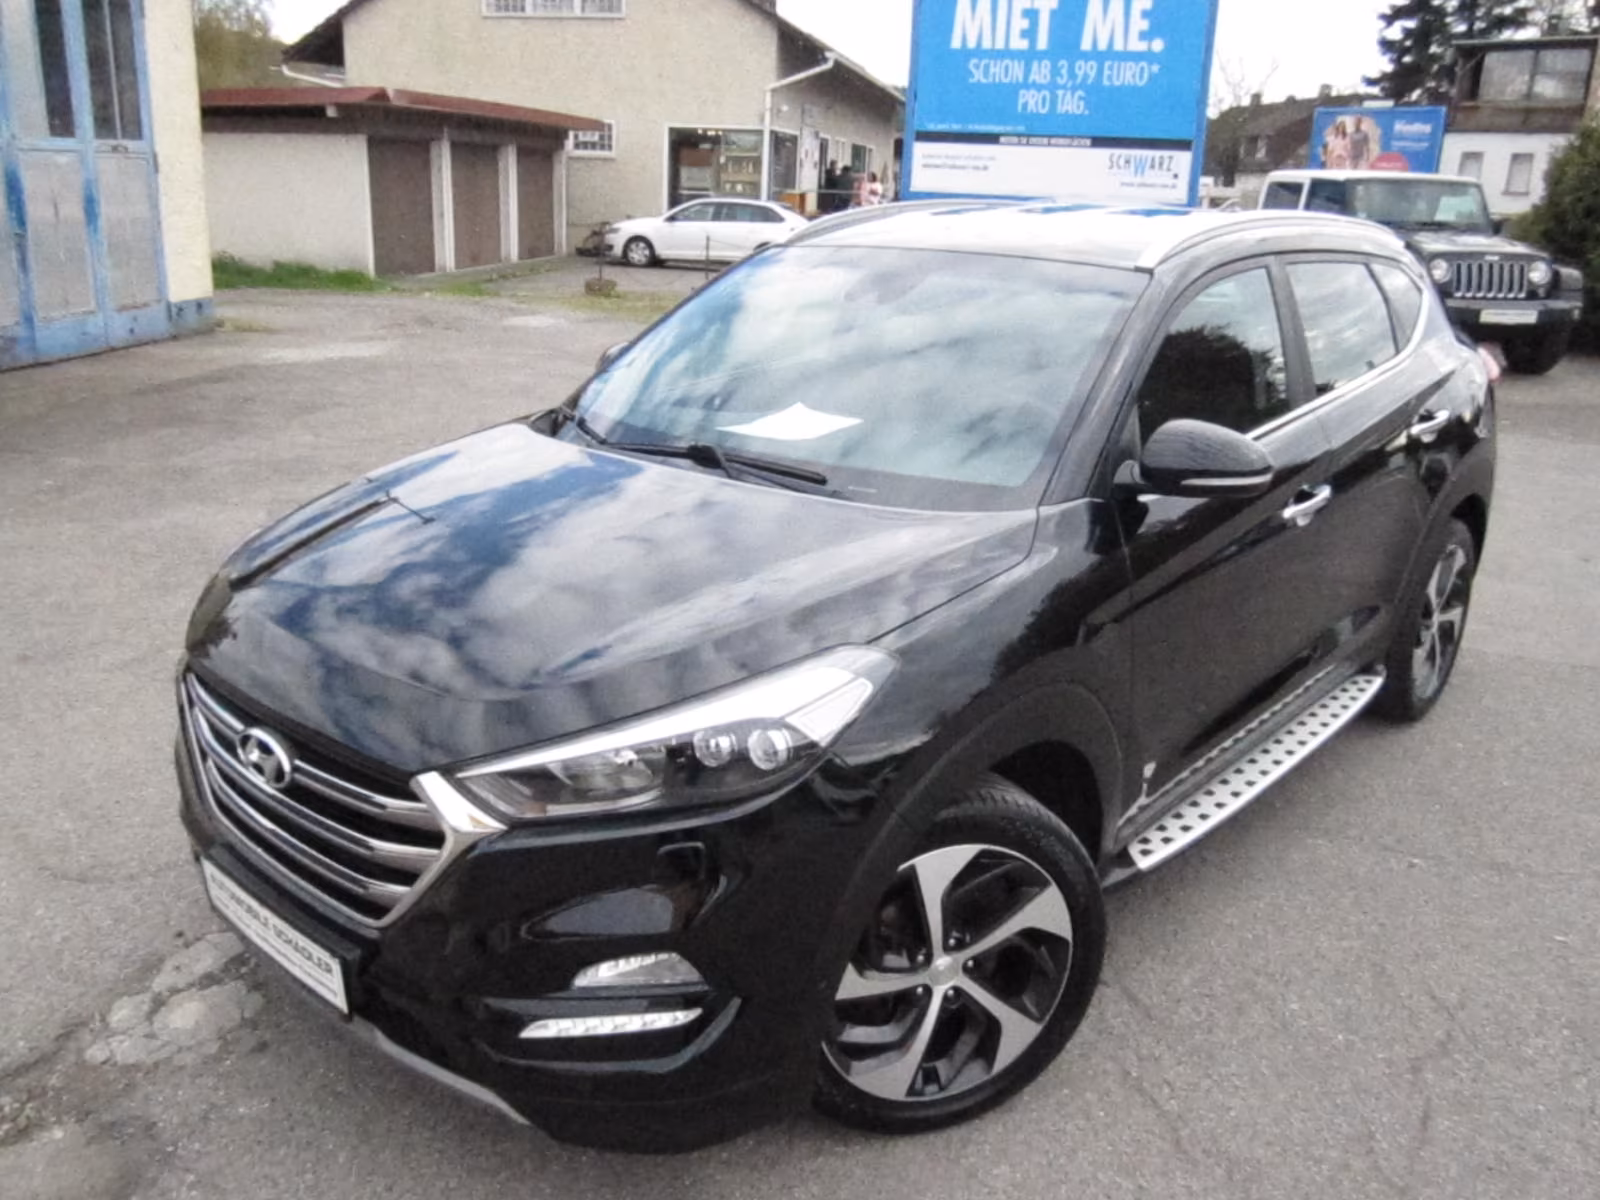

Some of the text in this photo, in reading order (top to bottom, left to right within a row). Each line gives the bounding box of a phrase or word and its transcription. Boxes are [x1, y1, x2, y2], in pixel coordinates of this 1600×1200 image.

[950, 0, 1165, 53] MIET ME.
[968, 58, 1025, 84] SCHON
[1028, 60, 1051, 84] AB
[1056, 60, 1098, 88] 3,99
[1017, 89, 1090, 115] PRO TAG.
